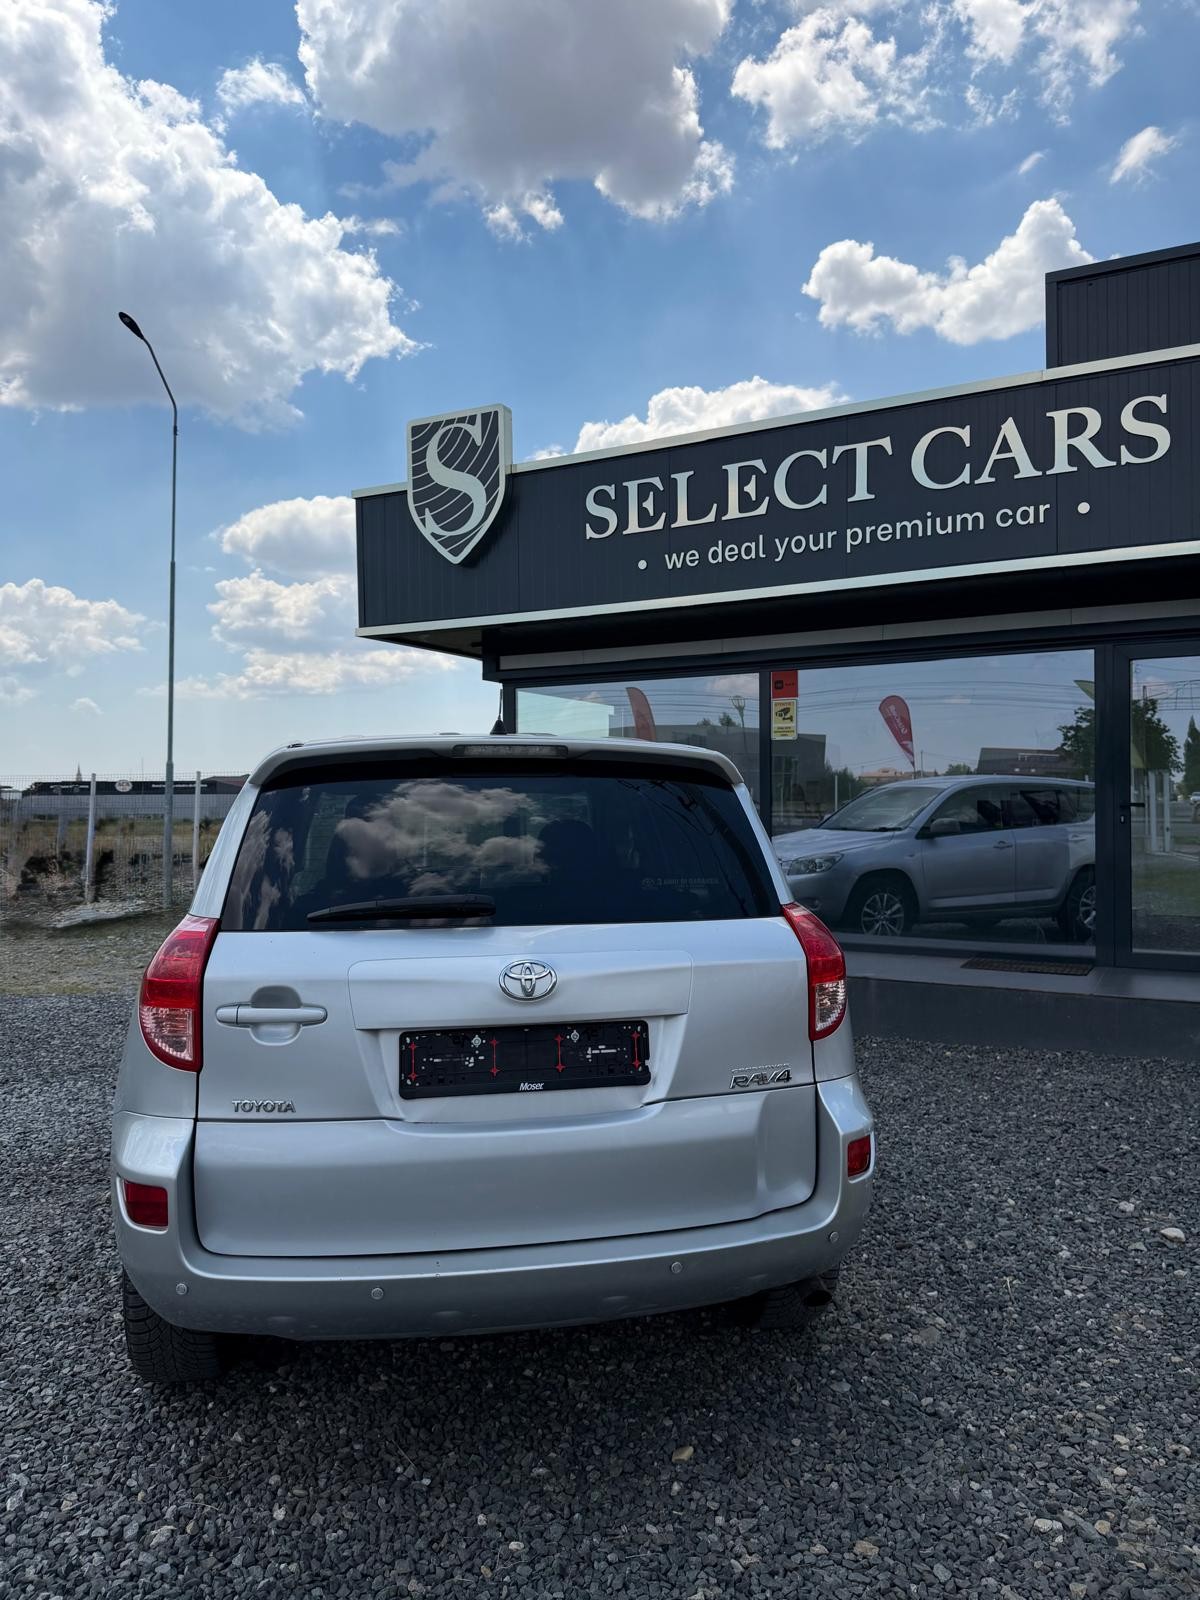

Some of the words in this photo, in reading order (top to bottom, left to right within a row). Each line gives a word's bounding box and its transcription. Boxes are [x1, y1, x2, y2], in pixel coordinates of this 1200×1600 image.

[585, 436, 893, 540] SELECT
[911, 394, 1171, 490] CARS
[664, 550, 700, 570] we
[708, 534, 766, 564] deal
[775, 530, 838, 562] your
[846, 510, 985, 553] premium
[995, 503, 1051, 527] car
[519, 1082, 545, 1091] Moser
[729, 1067, 792, 1089] RAV4
[231, 1099, 296, 1113] TOYOTA
